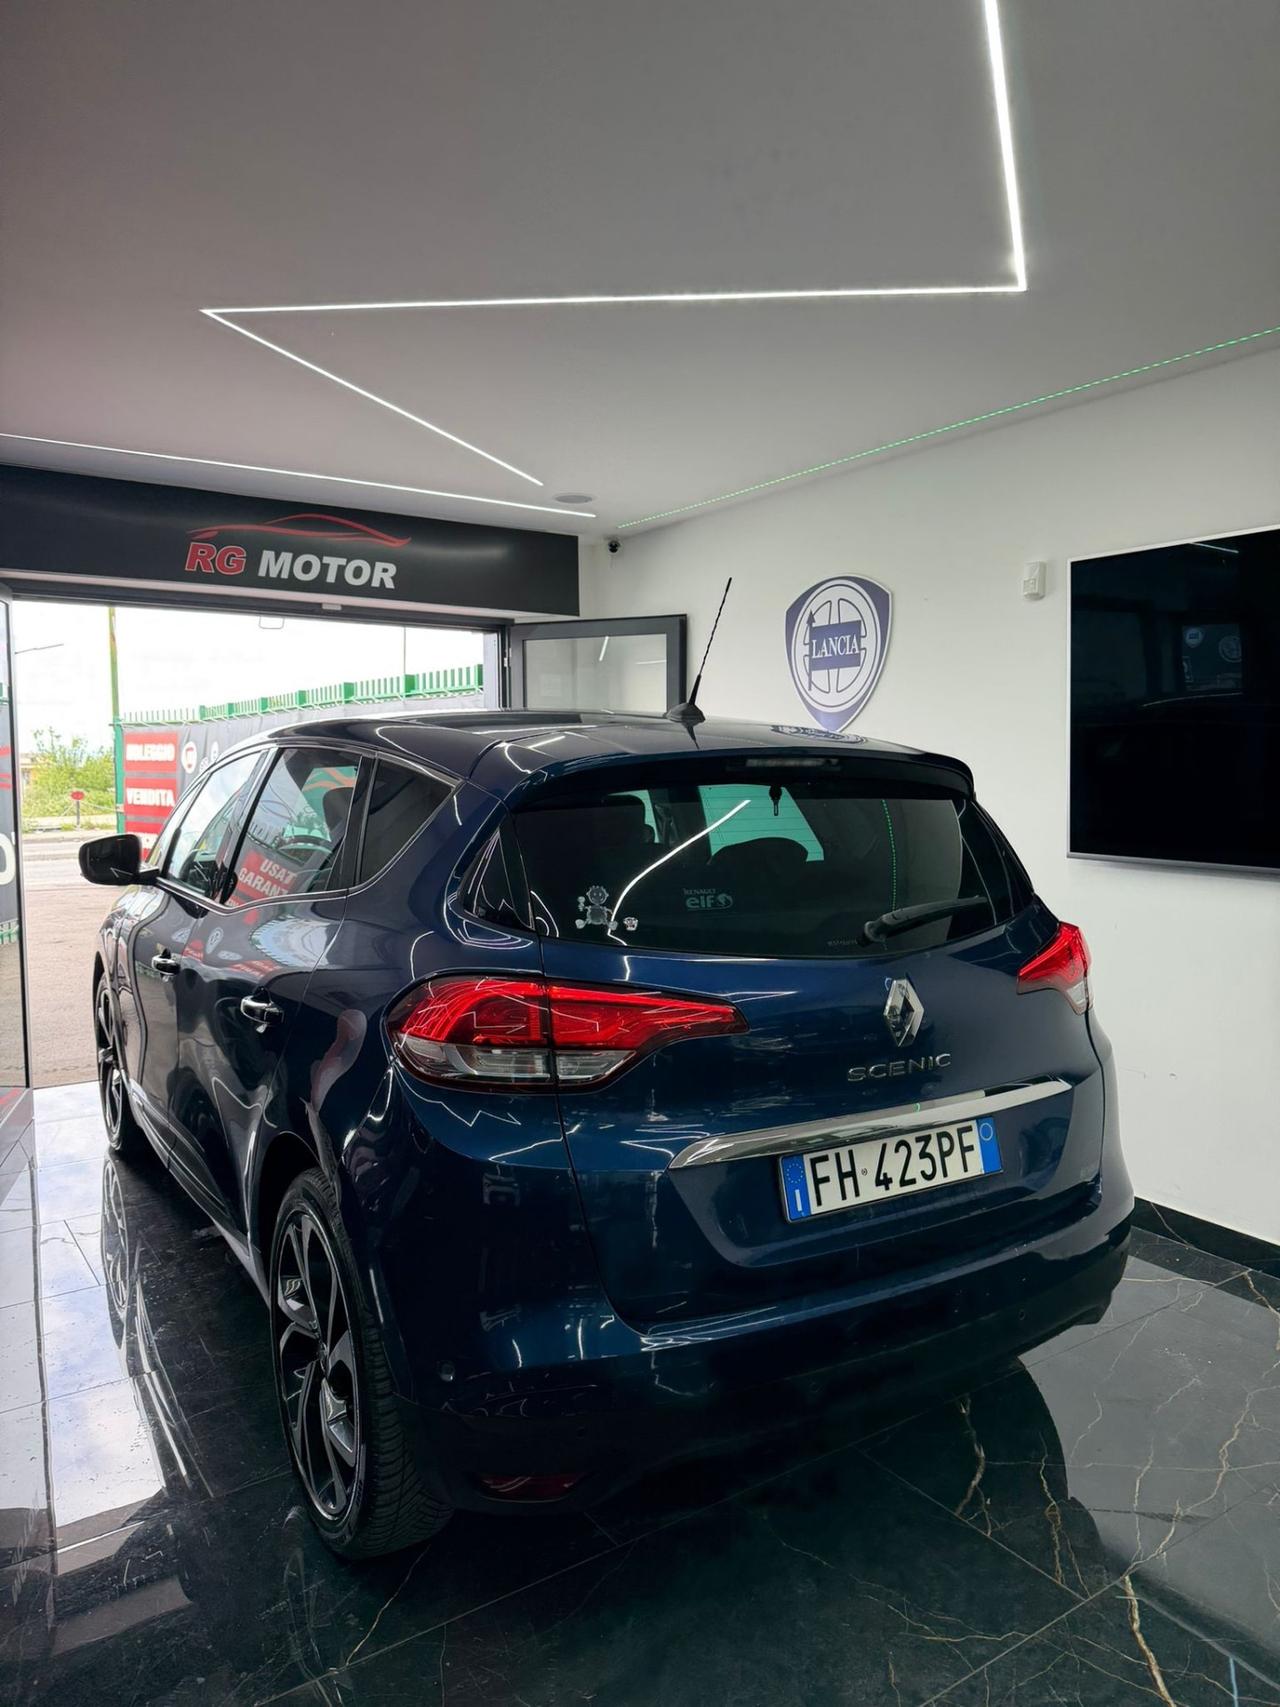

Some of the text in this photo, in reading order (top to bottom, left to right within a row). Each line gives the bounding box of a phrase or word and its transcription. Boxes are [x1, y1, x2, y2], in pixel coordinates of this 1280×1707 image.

[185, 542, 397, 589] RG MOTOR
[812, 634, 860, 659] LANCIA
[126, 788, 175, 807] VENDITA
[686, 895, 715, 908] elf
[847, 1053, 951, 1081] SCENIC
